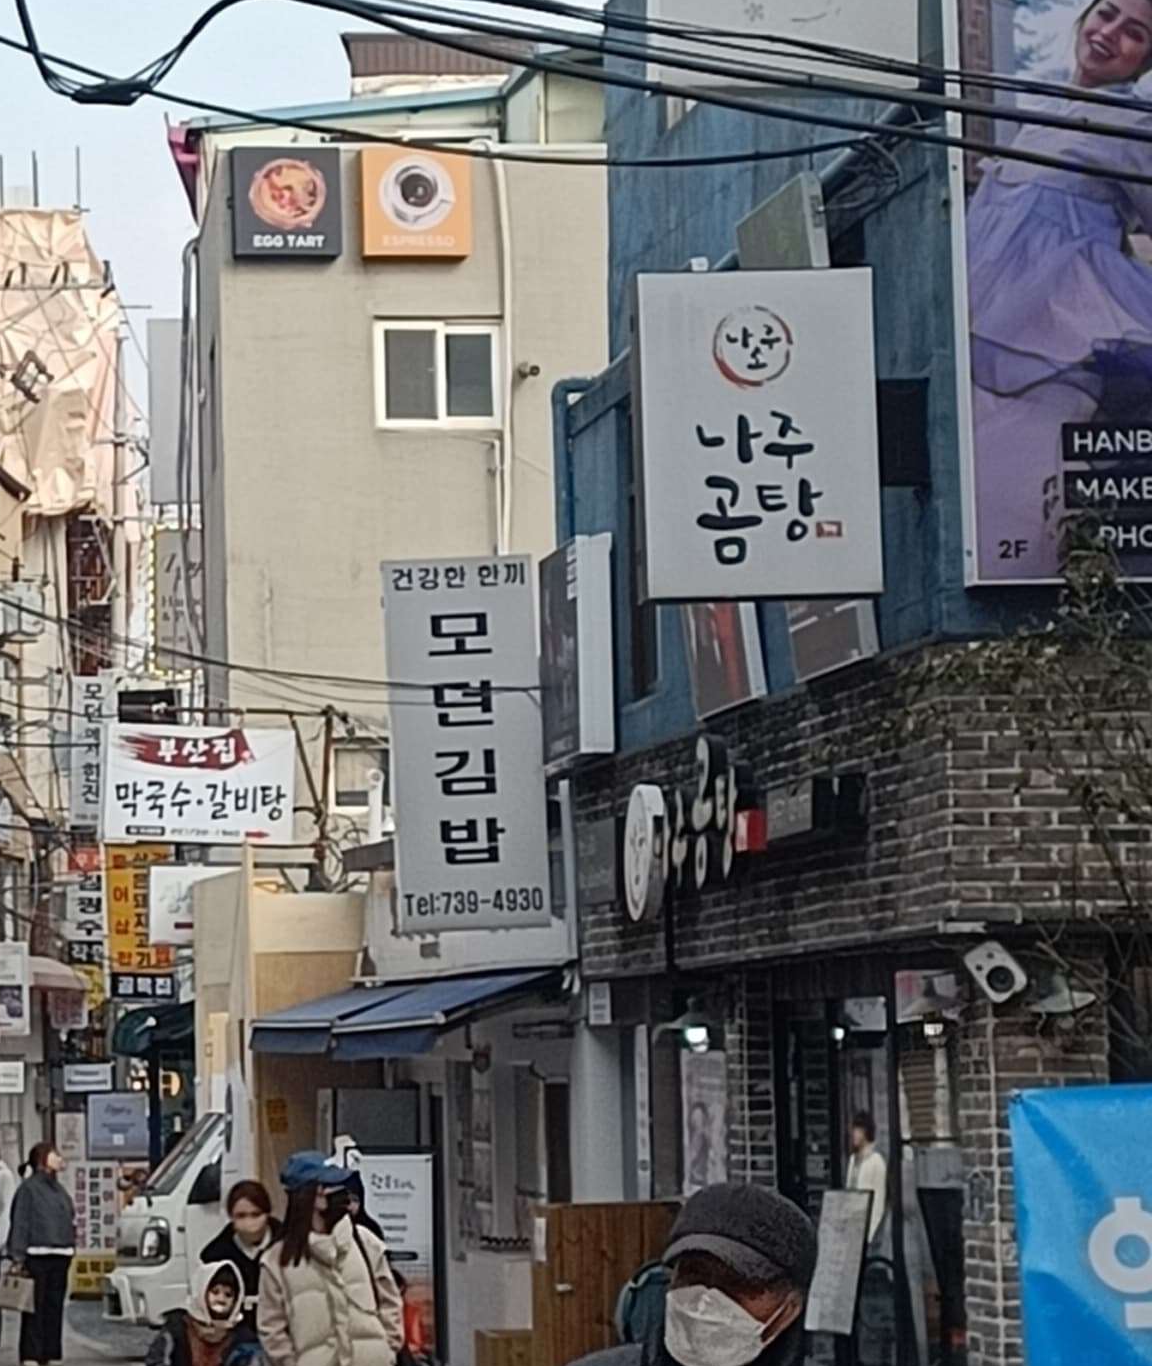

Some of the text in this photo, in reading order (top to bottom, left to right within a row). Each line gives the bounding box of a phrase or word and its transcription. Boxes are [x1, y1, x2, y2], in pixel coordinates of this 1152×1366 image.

[253, 235, 325, 248] EGG TART
[726, 324, 782, 350] 나주
[747, 346, 768, 370] 소
[696, 410, 815, 469] 나주
[696, 476, 824, 565] 곰탕
[999, 539, 1029, 559] 2F
[158, 737, 236, 764] 부산집
[429, 612, 506, 865] 모던김밥
[403, 887, 544, 917] Tel:739-4930
